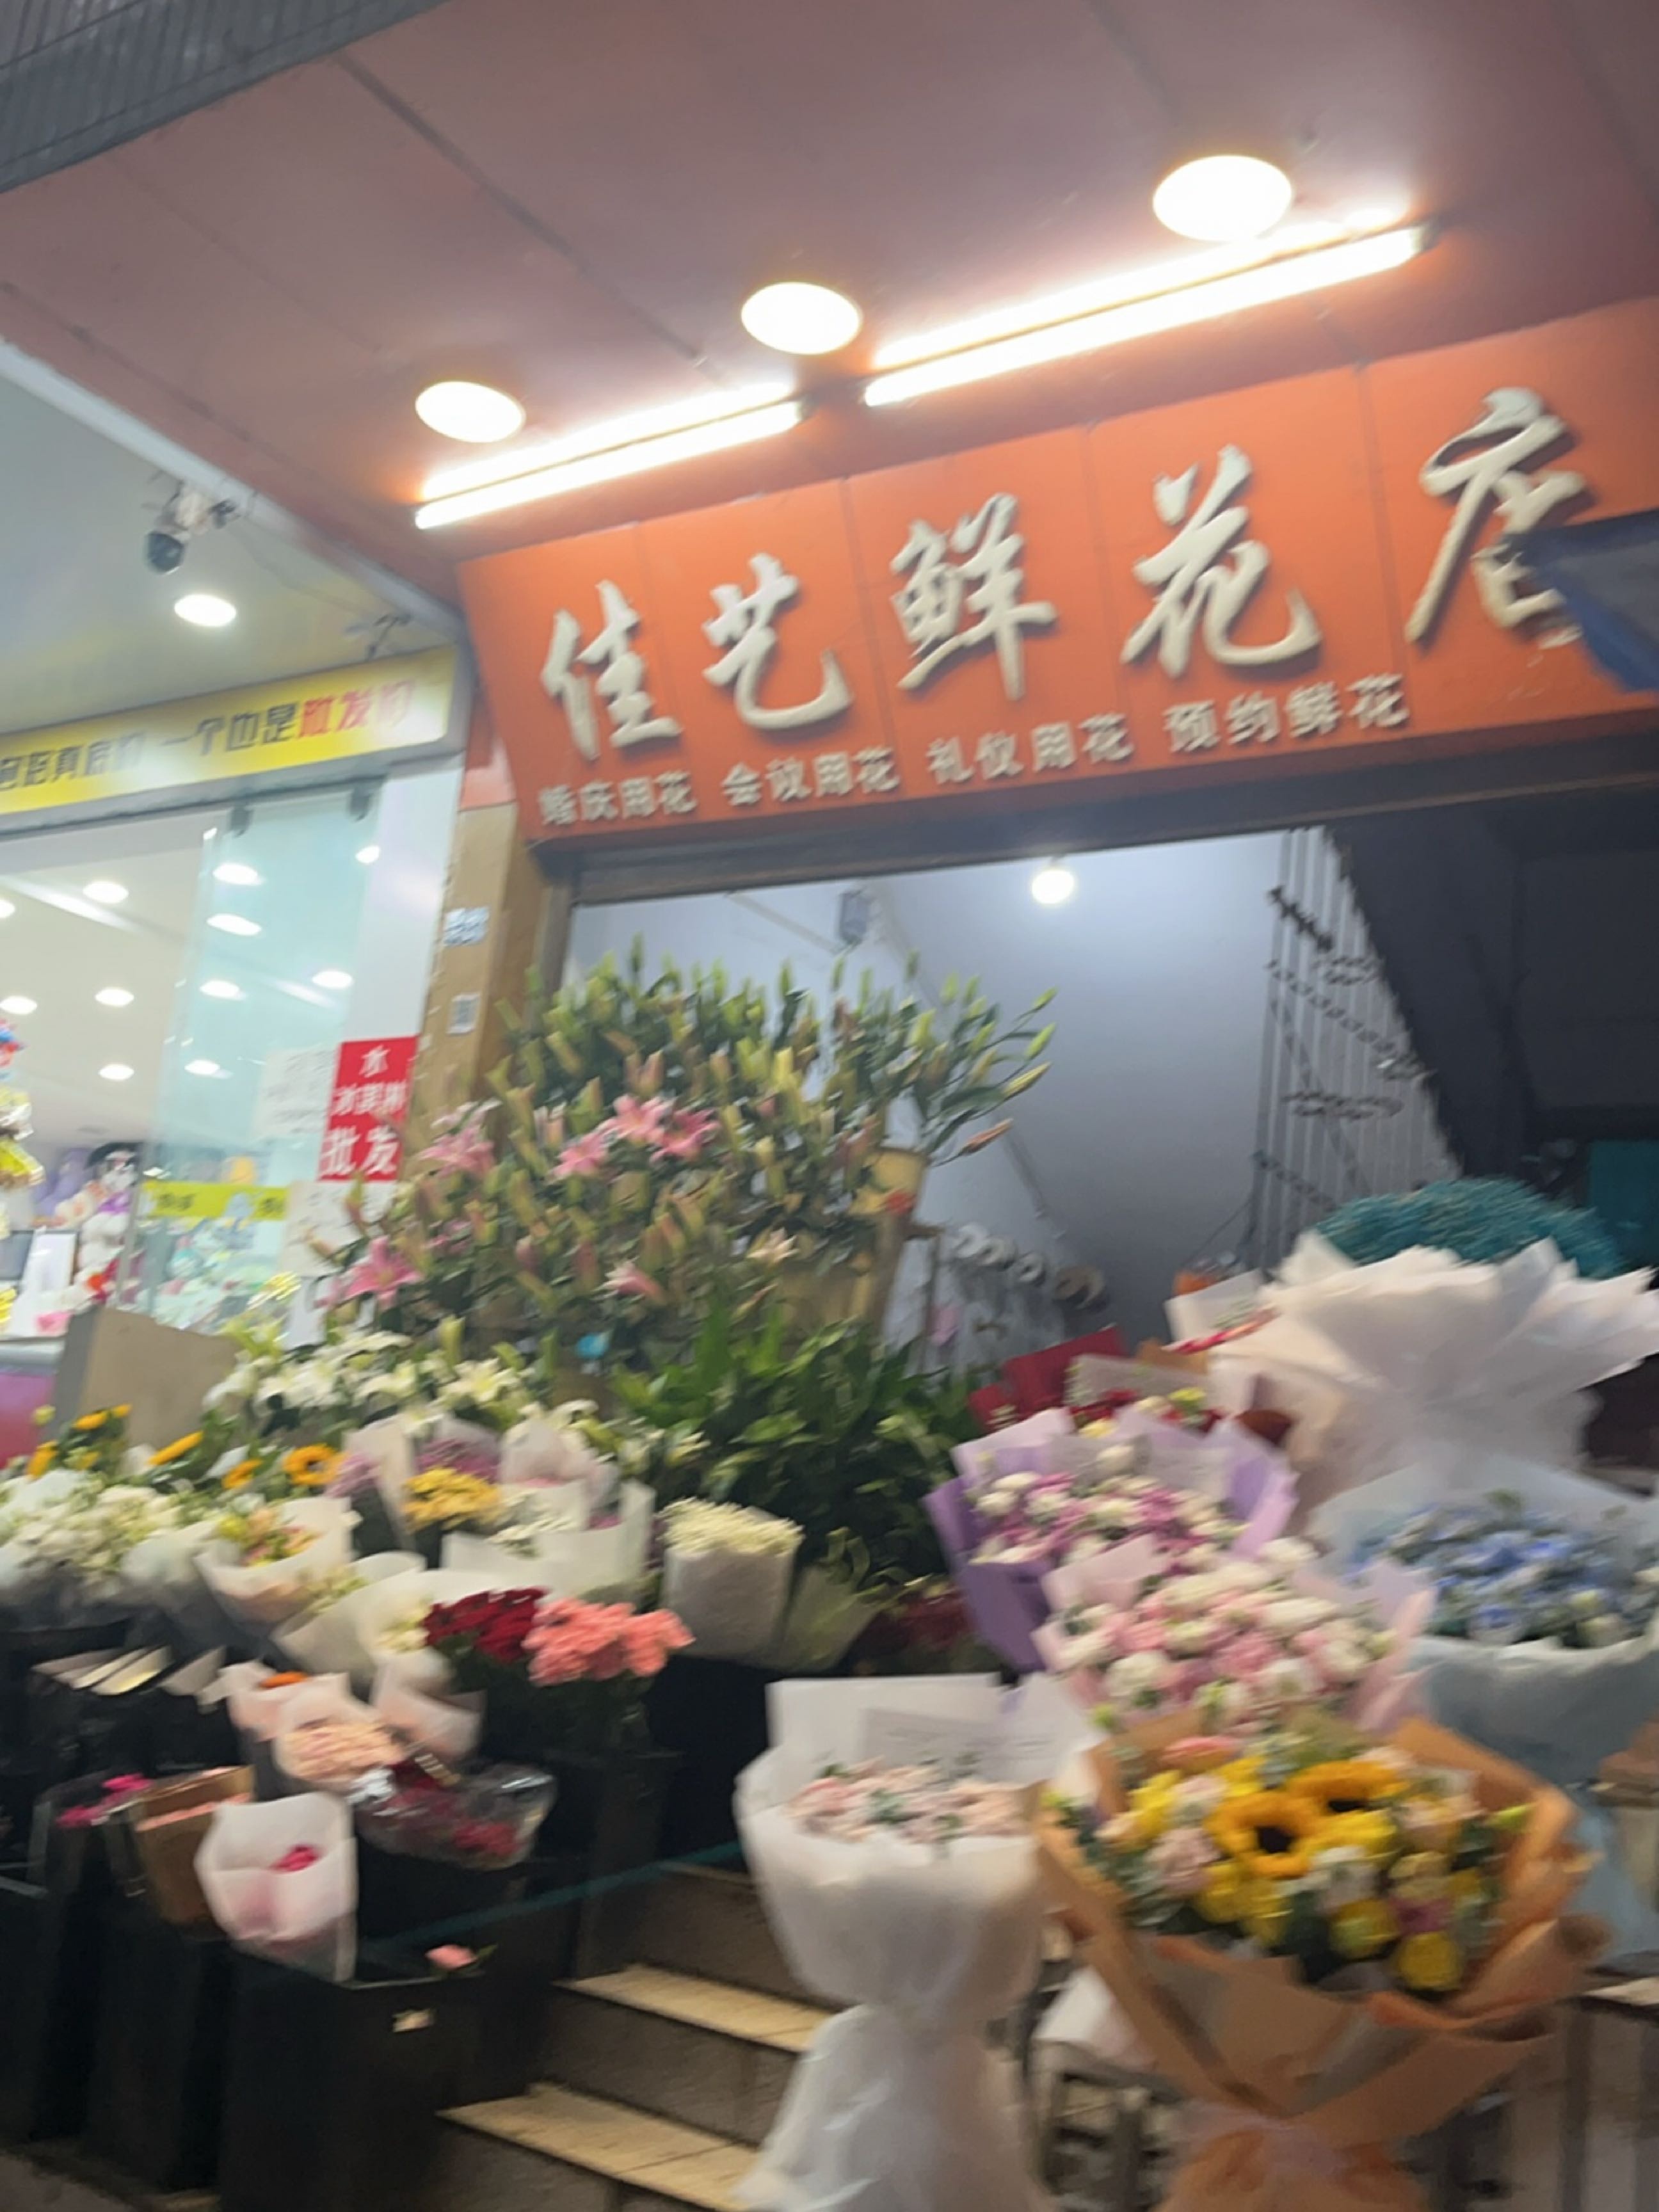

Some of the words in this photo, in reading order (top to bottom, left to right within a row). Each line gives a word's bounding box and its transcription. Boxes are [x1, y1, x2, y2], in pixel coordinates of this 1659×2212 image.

[540, 387, 1585, 760] 佳艺鲜花店
[538, 770, 698, 826] 婚庆用花
[722, 746, 900, 807] 会议用花
[926, 712, 1134, 785] 礼仪用花
[1163, 673, 1409, 753] 预约鲜花
